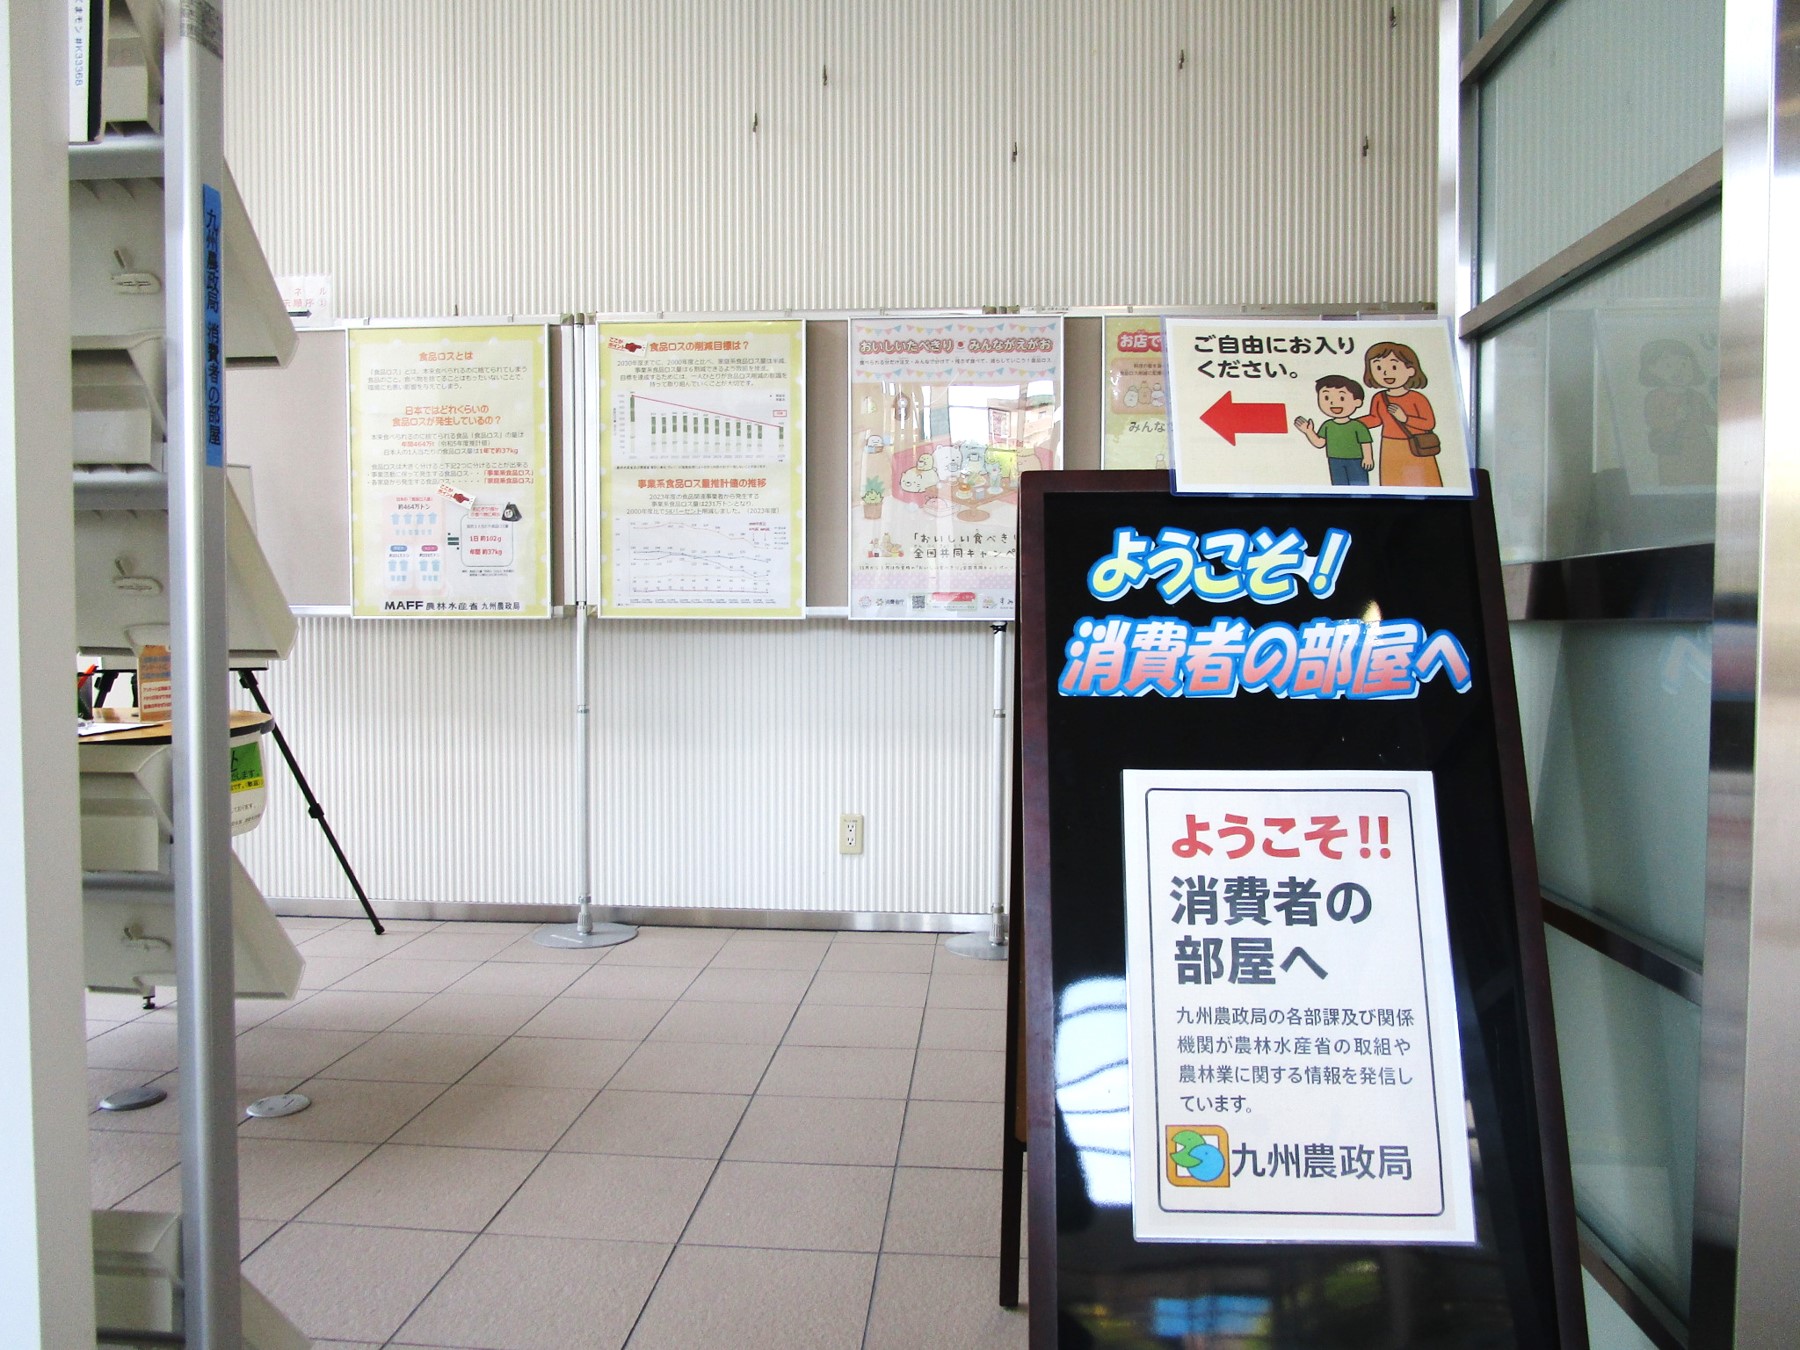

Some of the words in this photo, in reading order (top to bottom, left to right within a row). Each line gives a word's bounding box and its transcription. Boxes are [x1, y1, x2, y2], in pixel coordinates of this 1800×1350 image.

[650, 341, 749, 352] 食品ロスの削減目標は？
[1193, 335, 1356, 355] ご自由にお入り
[419, 351, 474, 362] 食品ロスとは
[1198, 359, 1299, 379] ください。
[405, 404, 489, 416] 日本ではどれくらいの
[392, 415, 502, 427] 食品ロスが発生しているの？
[638, 478, 768, 489] 事業系食品ロス量推計値の推移
[1087, 526, 1351, 604] ようこそ！
[385, 601, 424, 610] MAFF
[426, 602, 478, 611] 農林水産省
[482, 602, 521, 611] 九州農政局
[1058, 615, 1471, 699] 消費者の部屋へ
[1170, 874, 1372, 927] 消費者の
[1174, 935, 1329, 985] 部屋へ
[1176, 1006, 1416, 1027] 九州農政局の各部課及び関係
[1177, 1036, 1412, 1056] 機関が農林水産省の取組や
[1179, 1065, 1413, 1085] 農林業に関する情報を発信し
[1180, 1095, 1253, 1114] ています。
[1231, 1143, 1412, 1181] 九州農政局
